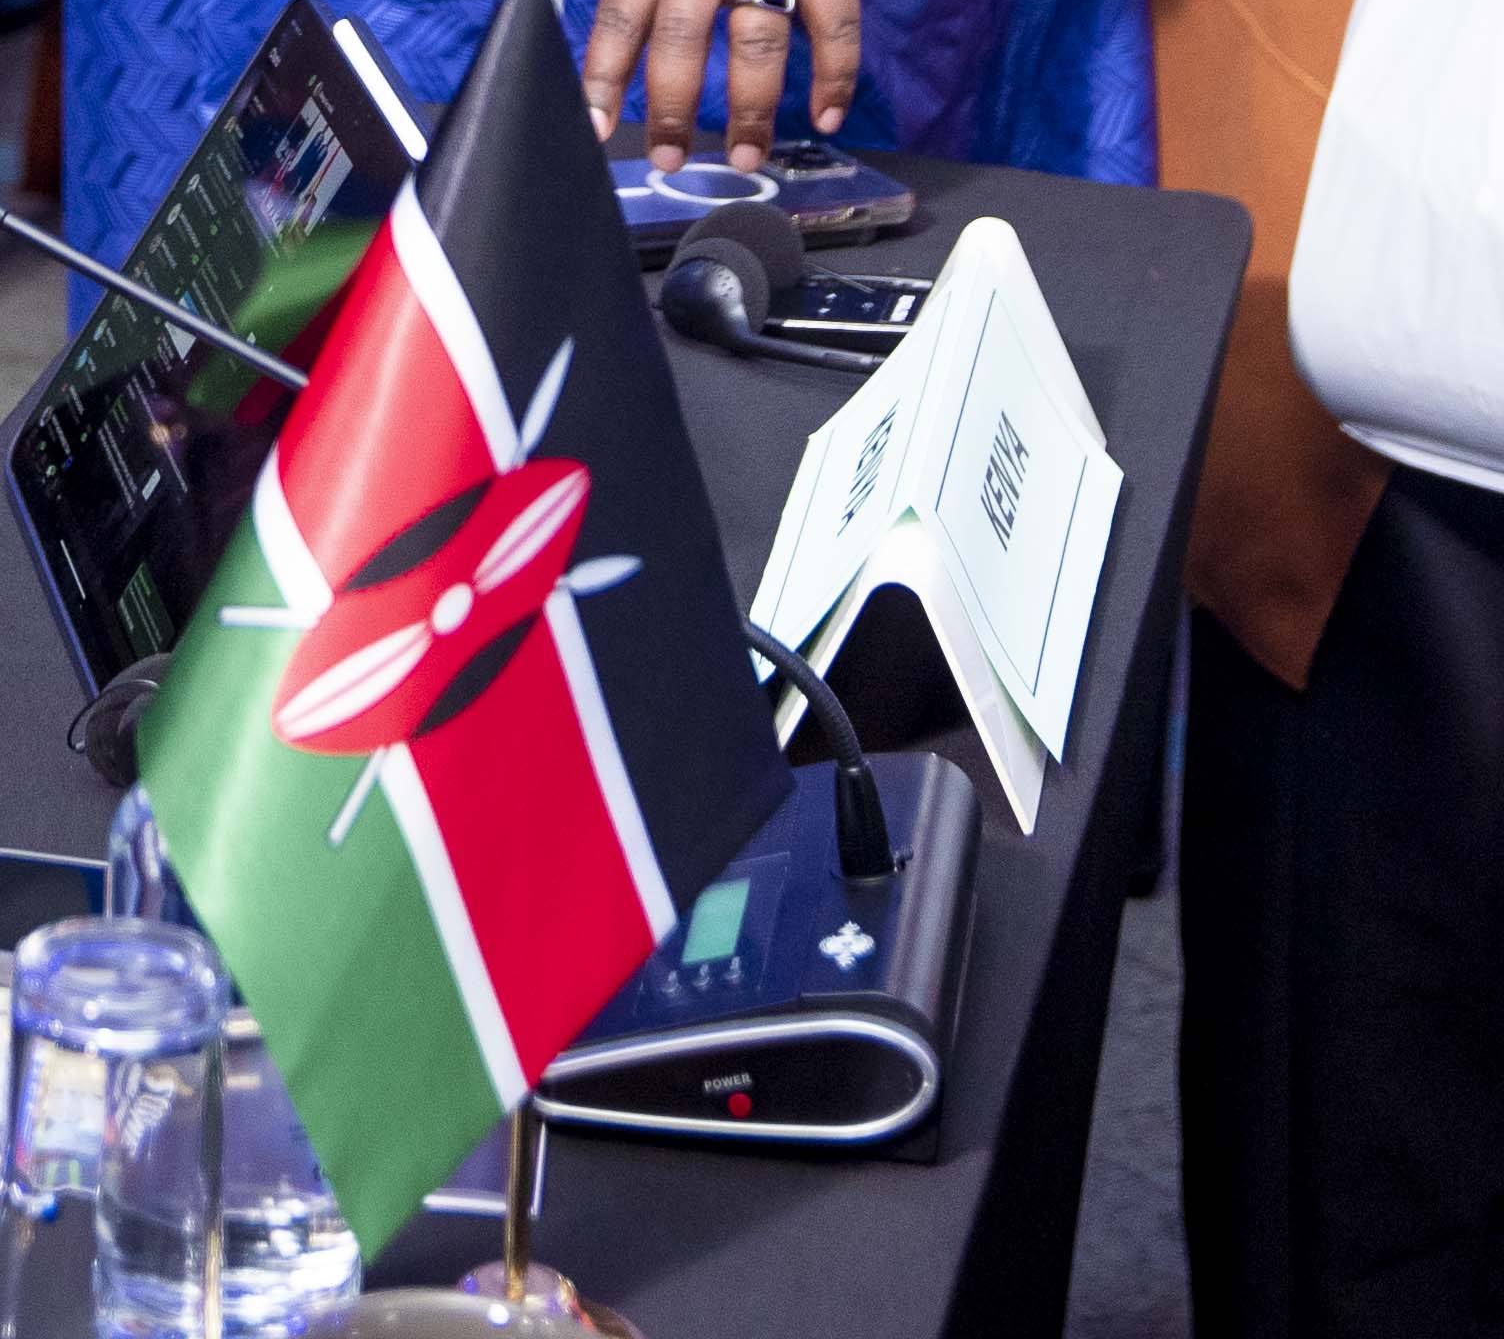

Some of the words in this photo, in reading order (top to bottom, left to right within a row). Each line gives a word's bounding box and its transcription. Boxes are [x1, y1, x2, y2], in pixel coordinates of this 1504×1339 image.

[836, 399, 900, 537] KENYA
[980, 409, 1029, 551] KENYA
[703, 1073, 752, 1091] POWER
